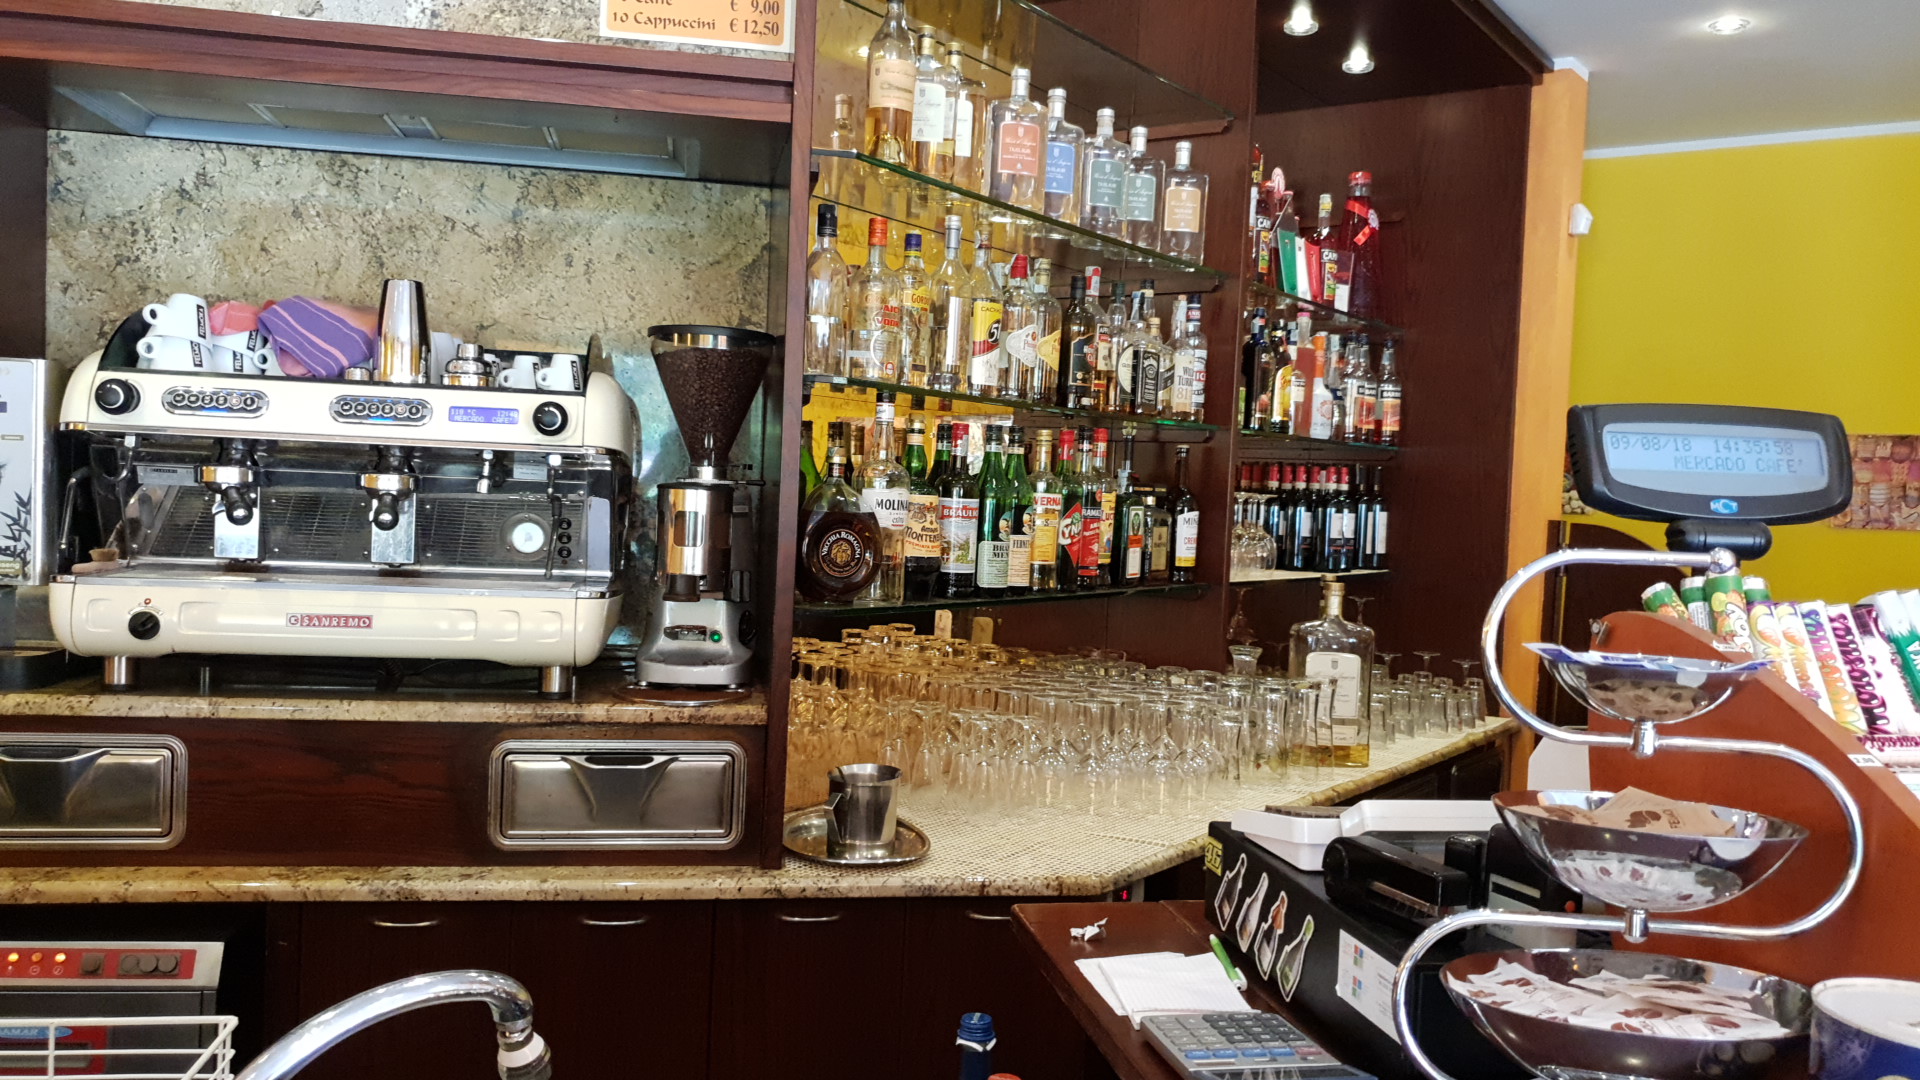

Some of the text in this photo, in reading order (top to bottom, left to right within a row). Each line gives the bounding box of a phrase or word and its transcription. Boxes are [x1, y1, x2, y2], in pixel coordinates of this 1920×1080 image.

[613, 11, 780, 37] 10 Cappuccini € 12,50
[197, 305, 206, 338] FELMOKA
[1610, 435, 1693, 453] 09/08/18
[1673, 455, 1746, 472] MERCADO
[302, 616, 370, 627] SANREMO
[1205, 842, 1222, 869] 46
